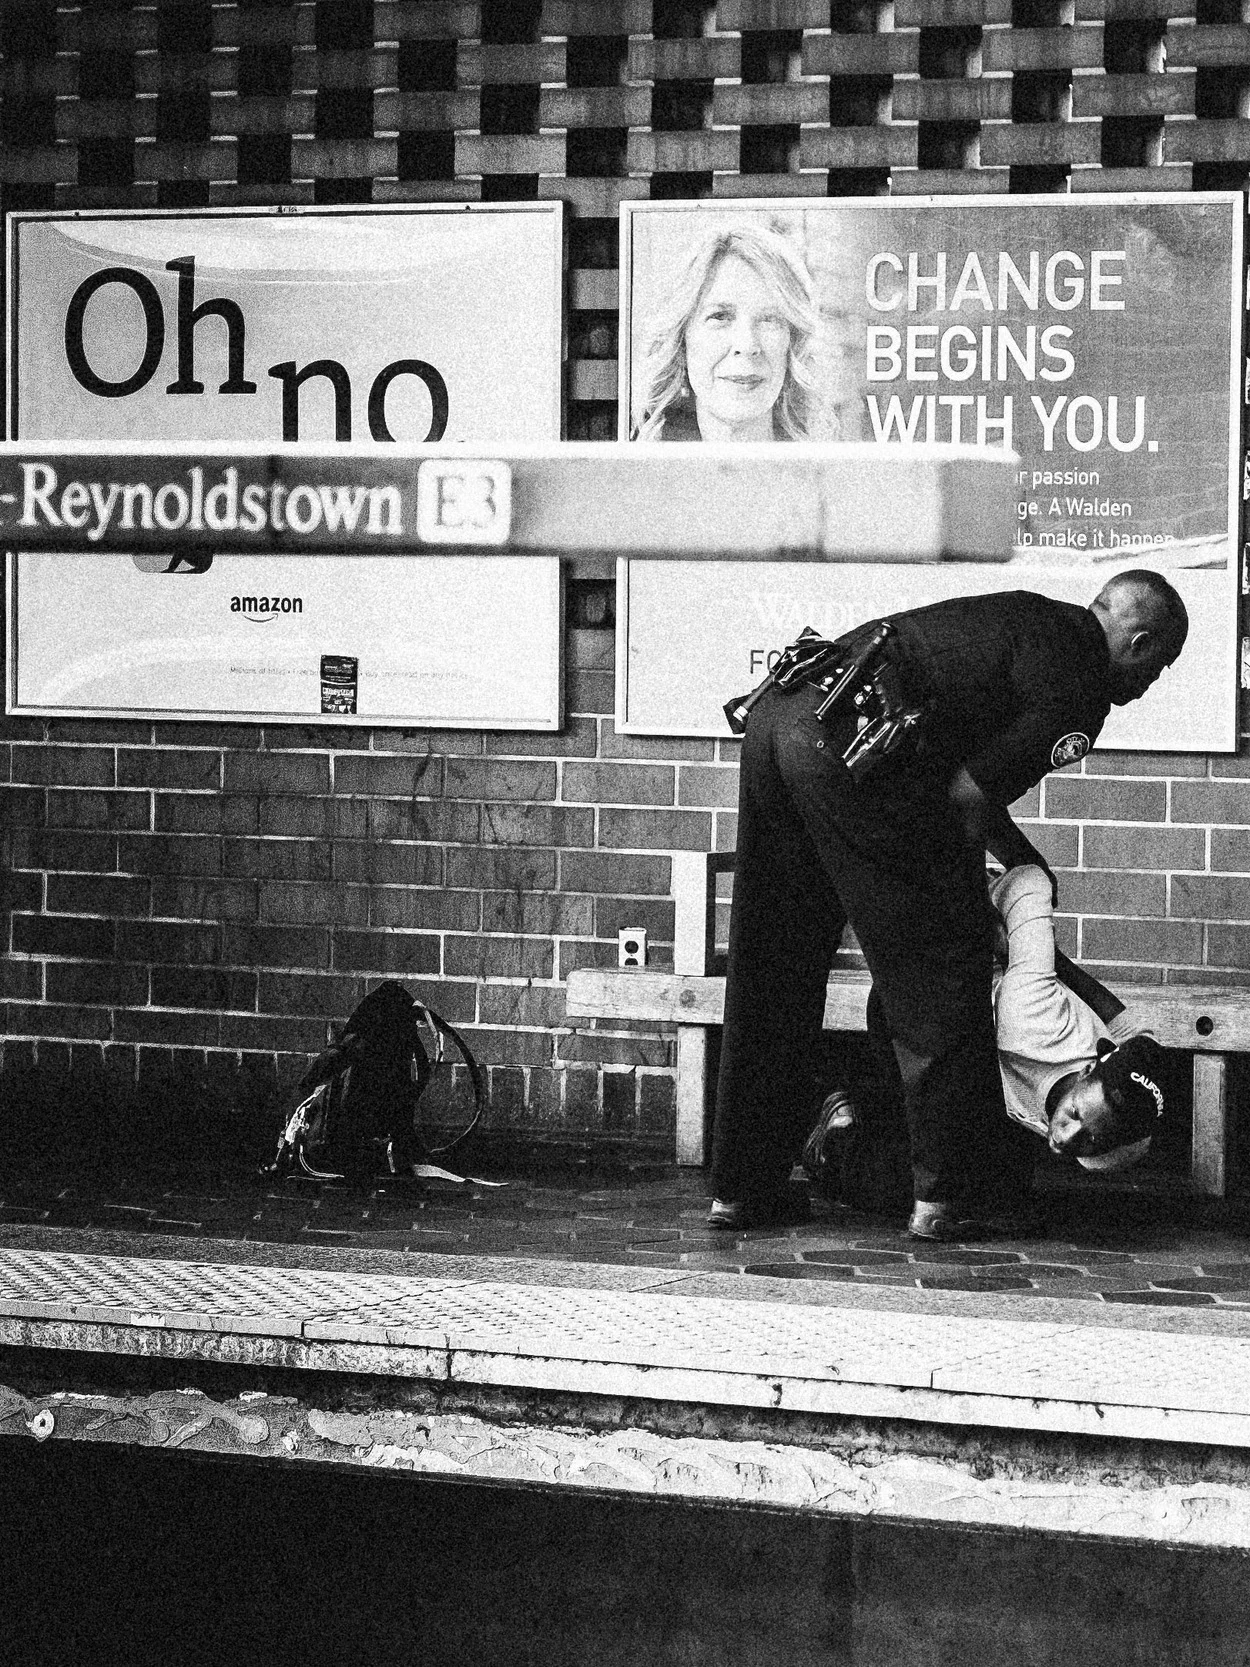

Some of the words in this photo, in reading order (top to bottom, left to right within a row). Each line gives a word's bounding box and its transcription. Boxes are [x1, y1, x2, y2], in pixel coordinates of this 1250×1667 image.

[866, 250, 1126, 311] CHANGE
[65, 256, 257, 398] Oh
[866, 325, 1075, 382] BEGINS
[268, 359, 464, 443] no
[867, 395, 1013, 450] WITH
[1031, 395, 1158, 452] YOU.
[433, 474, 498, 528] E3
[1032, 466, 1100, 490] passion
[1048, 496, 1062, 516] A
[1066, 496, 1132, 517] Walden
[1039, 529, 1087, 547] make
[1093, 528, 1104, 547] it
[230, 596, 303, 613] amazon
